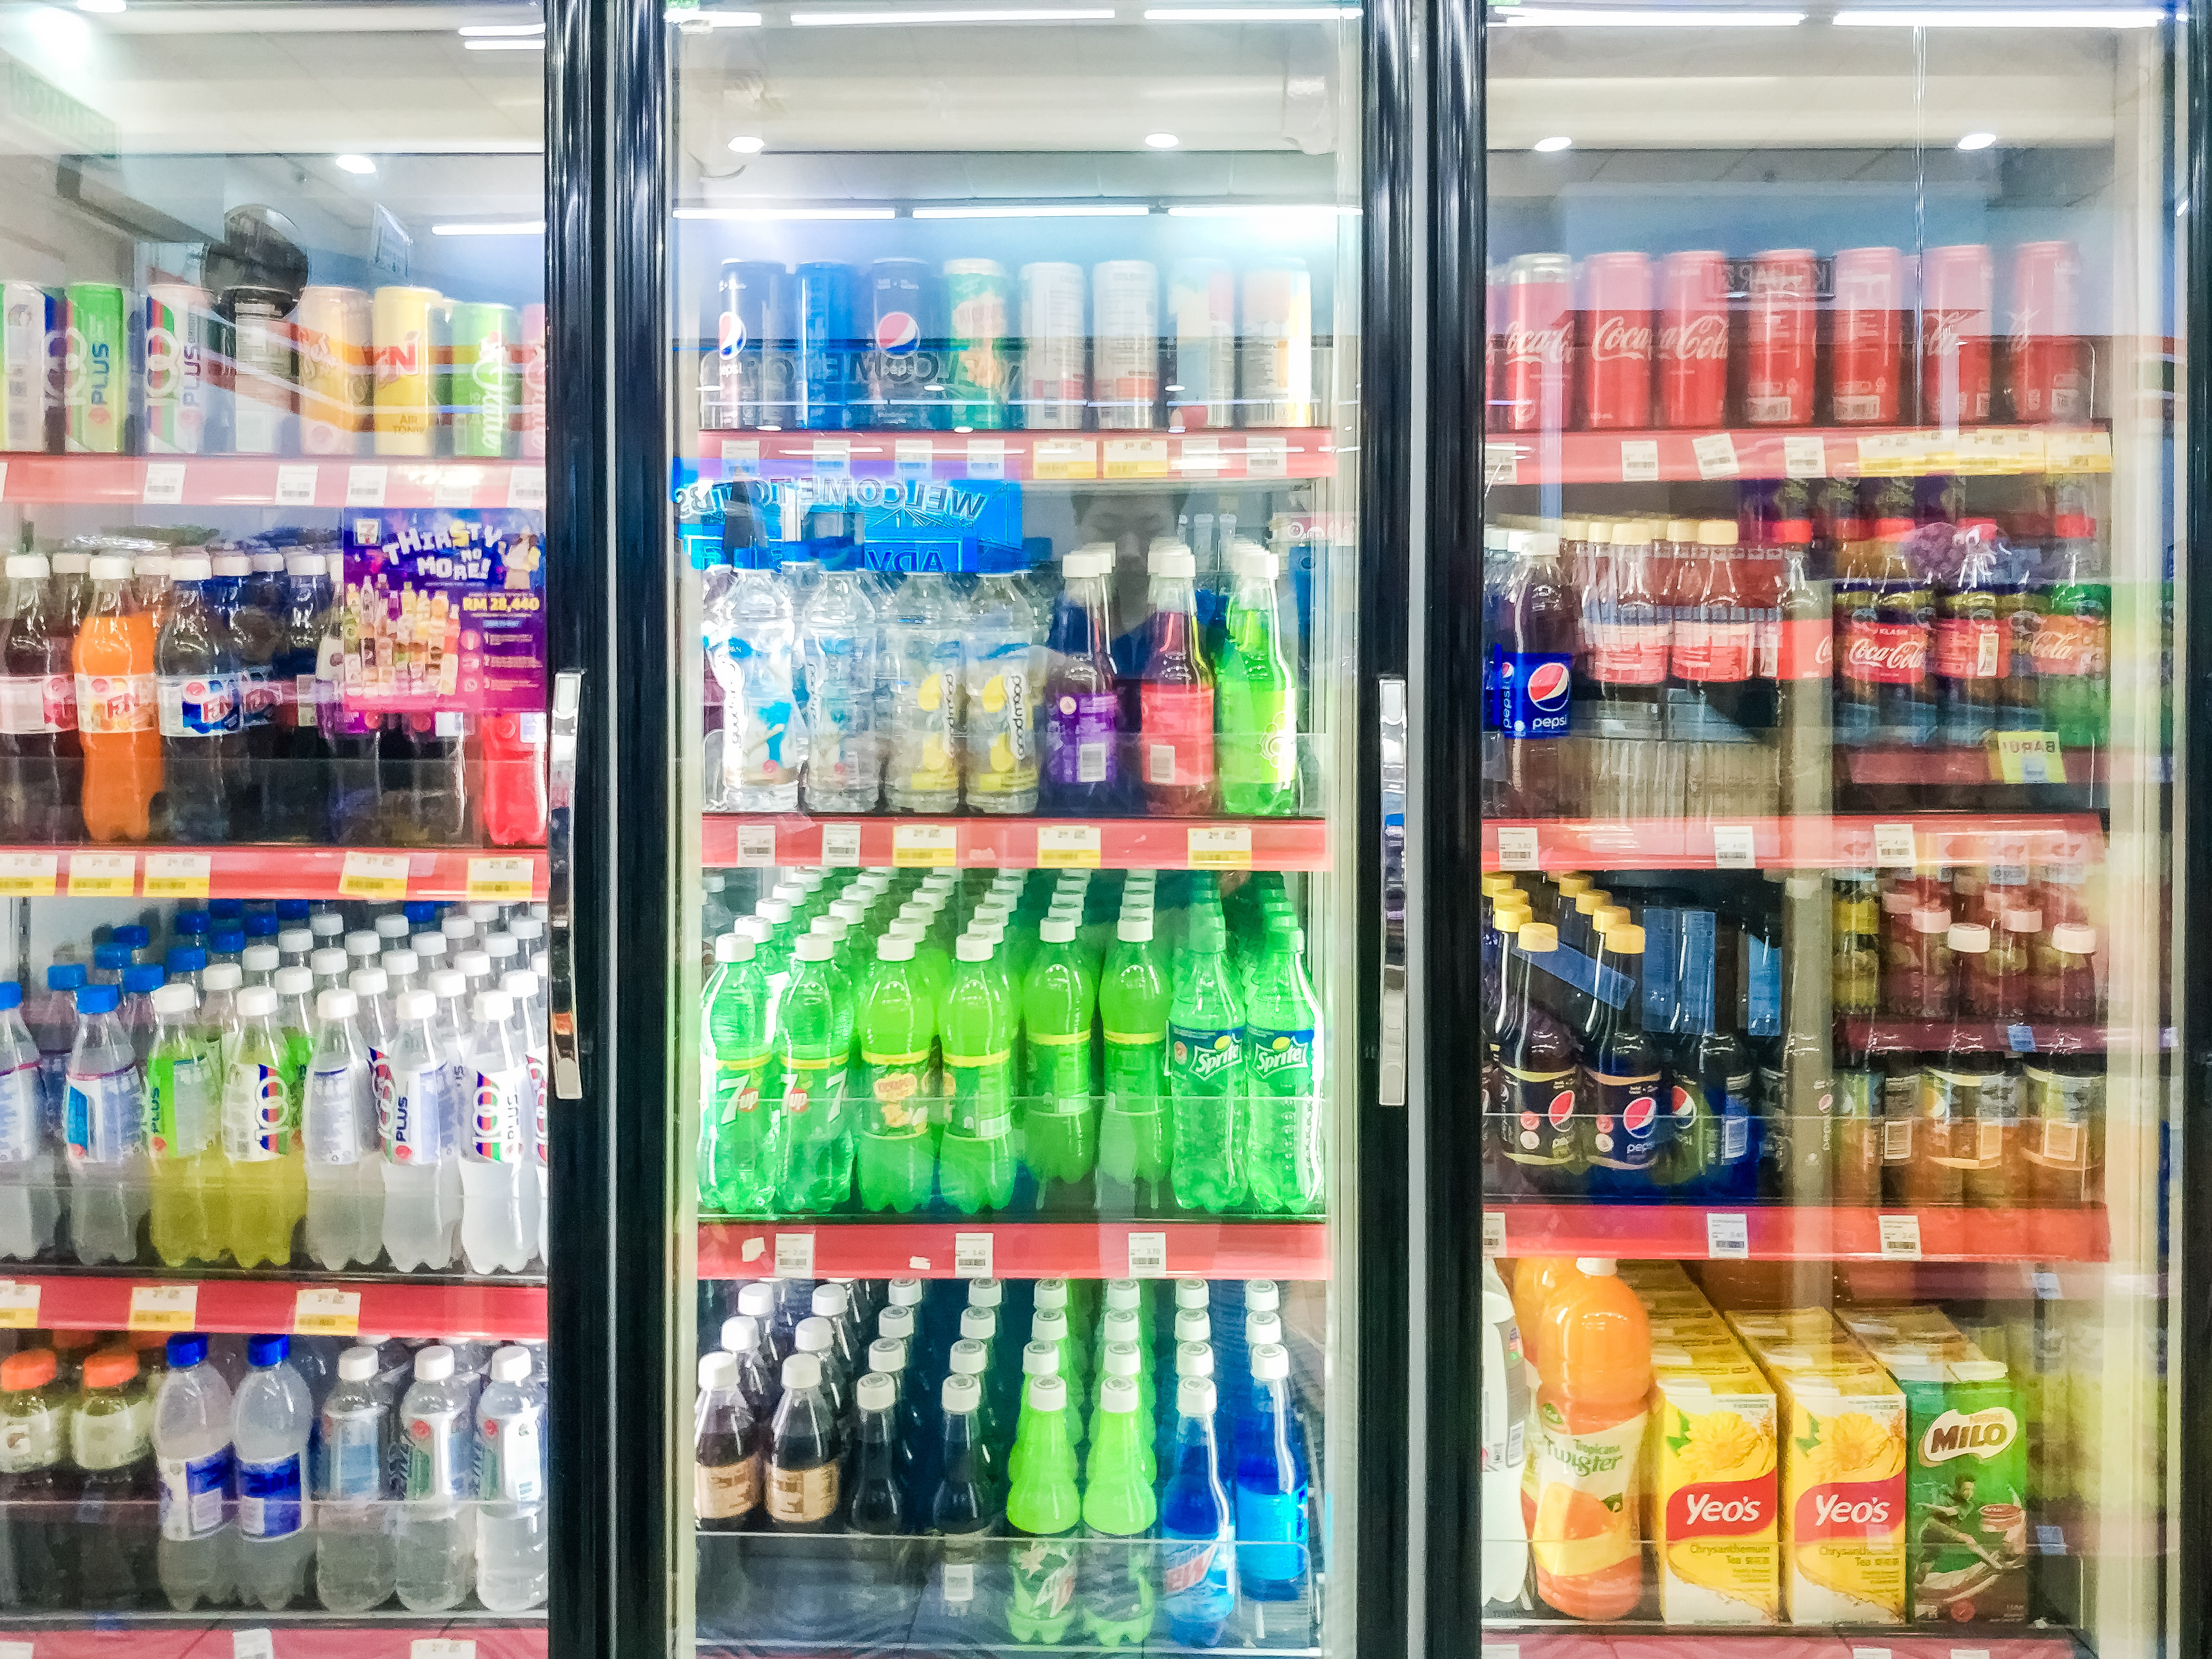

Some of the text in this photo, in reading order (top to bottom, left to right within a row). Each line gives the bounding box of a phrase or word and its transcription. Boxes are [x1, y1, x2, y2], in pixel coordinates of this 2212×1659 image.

[383, 520, 503, 566] THIRSTY
[461, 547, 482, 563] NO
[416, 555, 491, 581] MORE!
[1849, 638, 1924, 669] Coca-Cola
[1503, 685, 1512, 729] pepsi
[1532, 714, 1567, 731] pepsi
[1195, 1041, 1240, 1074] Sprite
[1256, 1044, 1304, 1073] Sprite
[395, 1095, 408, 1142] PLUS
[1930, 1423, 2008, 1454] MILO
[1687, 1493, 1761, 1525] Yeo's
[1815, 1494, 1891, 1526] Yeo's
